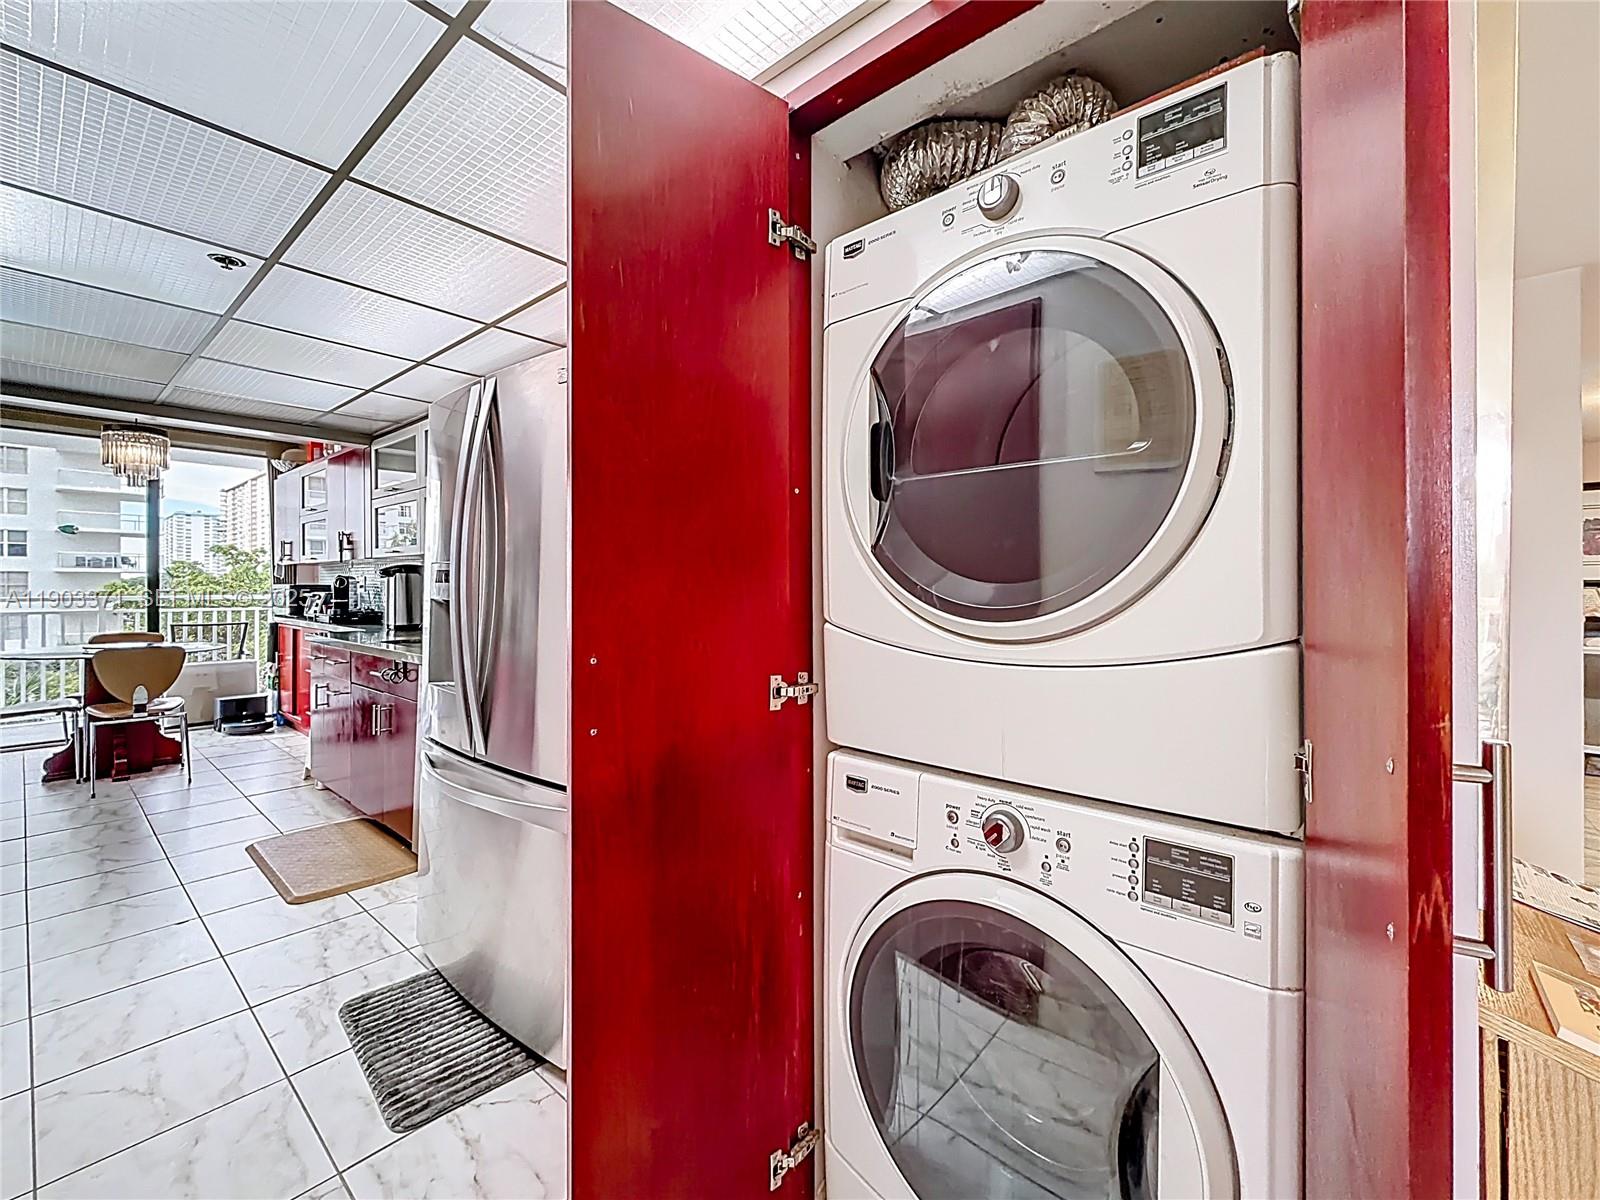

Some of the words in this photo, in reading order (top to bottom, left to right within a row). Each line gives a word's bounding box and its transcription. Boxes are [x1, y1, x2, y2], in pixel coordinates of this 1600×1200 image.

[1051, 160, 1067, 170] start
[941, 206, 957, 216] power
[945, 803, 961, 811] power
[1056, 830, 1071, 839] start
